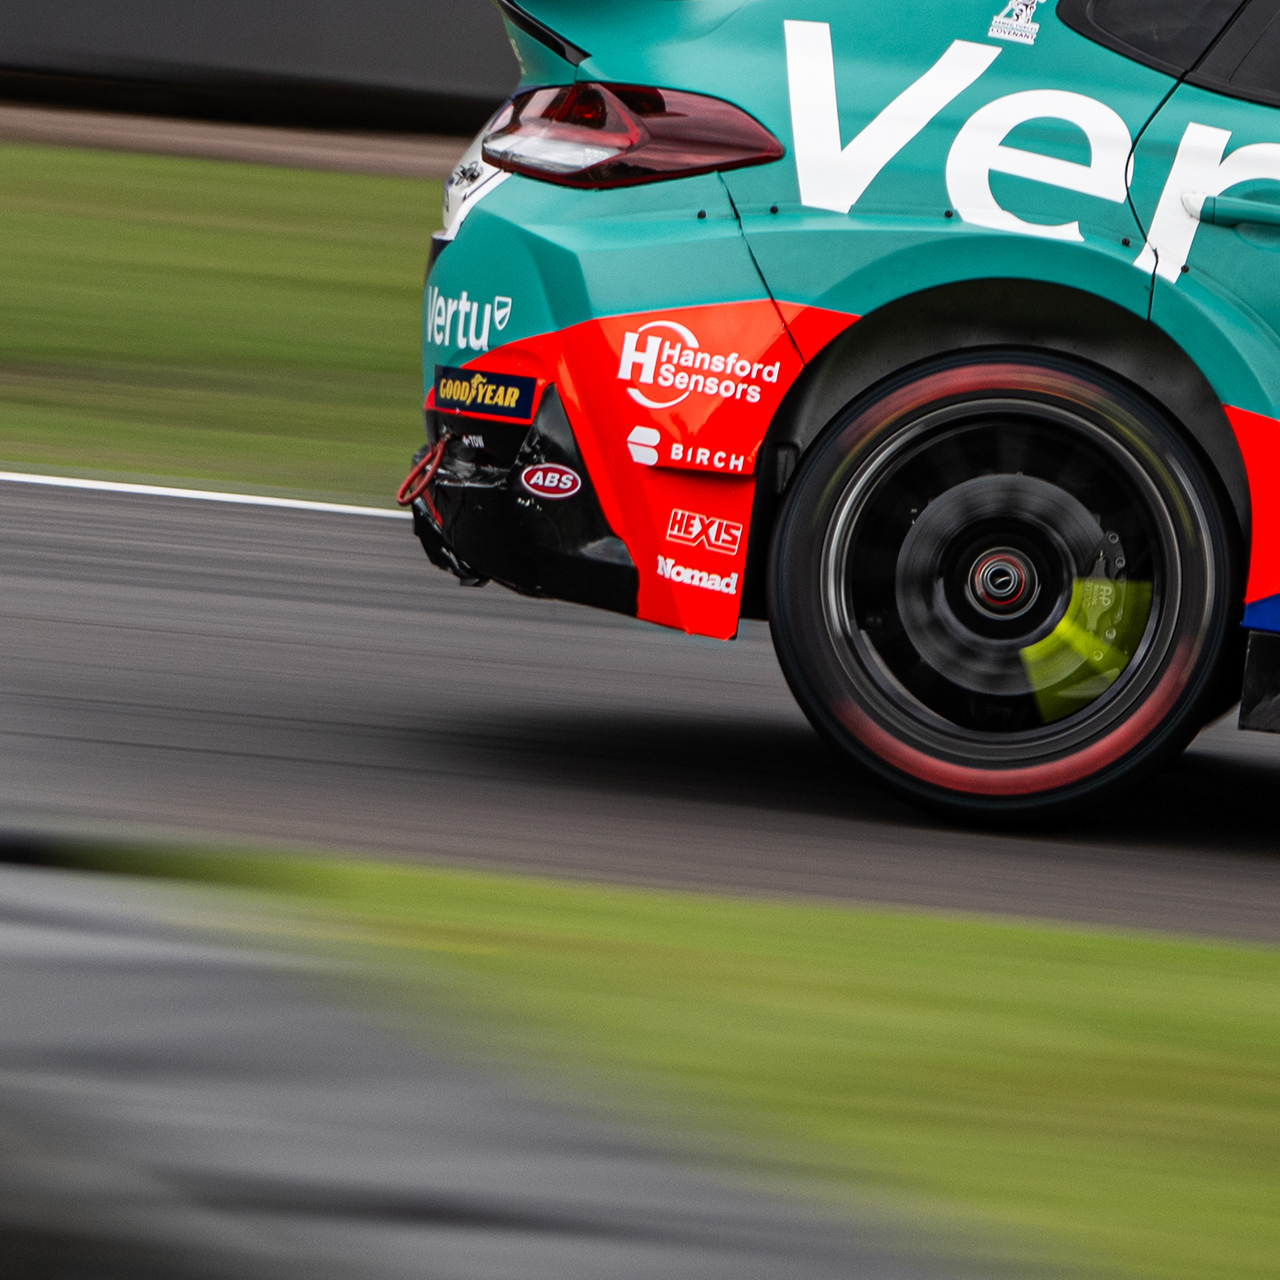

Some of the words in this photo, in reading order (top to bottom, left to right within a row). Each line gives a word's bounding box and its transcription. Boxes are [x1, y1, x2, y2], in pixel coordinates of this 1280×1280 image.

[991, 28, 1034, 39] COVENANT
[661, 340, 780, 383] Hansford
[657, 364, 761, 403] Sensors
[671, 443, 744, 472] BIRCH
[530, 471, 574, 490] ABS
[668, 509, 742, 551] HEXIS
[657, 555, 738, 595] Nomad
